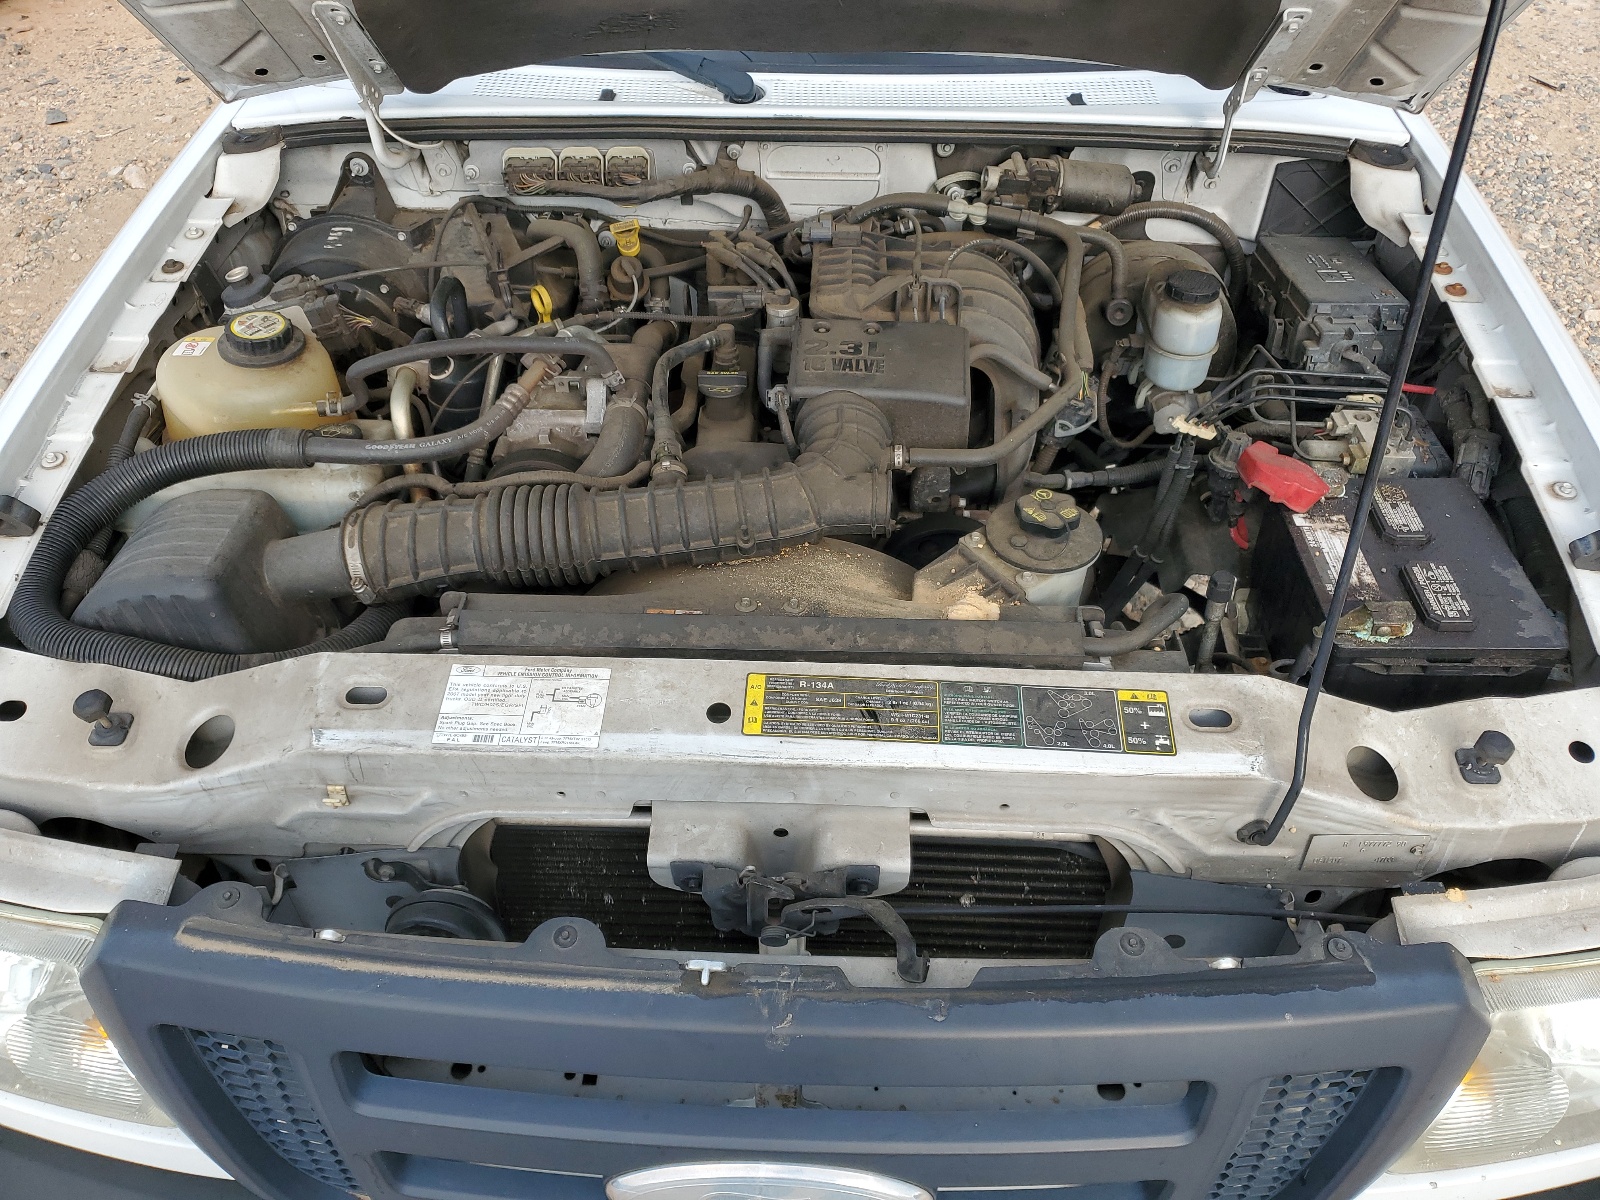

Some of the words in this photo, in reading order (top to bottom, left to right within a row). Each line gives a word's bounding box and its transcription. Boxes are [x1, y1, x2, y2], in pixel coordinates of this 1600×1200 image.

[804, 340, 885, 357] 2.3L
[803, 358, 827, 372] 16
[831, 358, 885, 373] VALVE
[365, 443, 416, 452] GOODYEAR
[419, 437, 453, 448] GALAXY
[799, 680, 834, 689] R-134A
[1123, 706, 1143, 714] 50%
[501, 736, 538, 744] CATALYST
[1127, 736, 1147, 744] 50%
